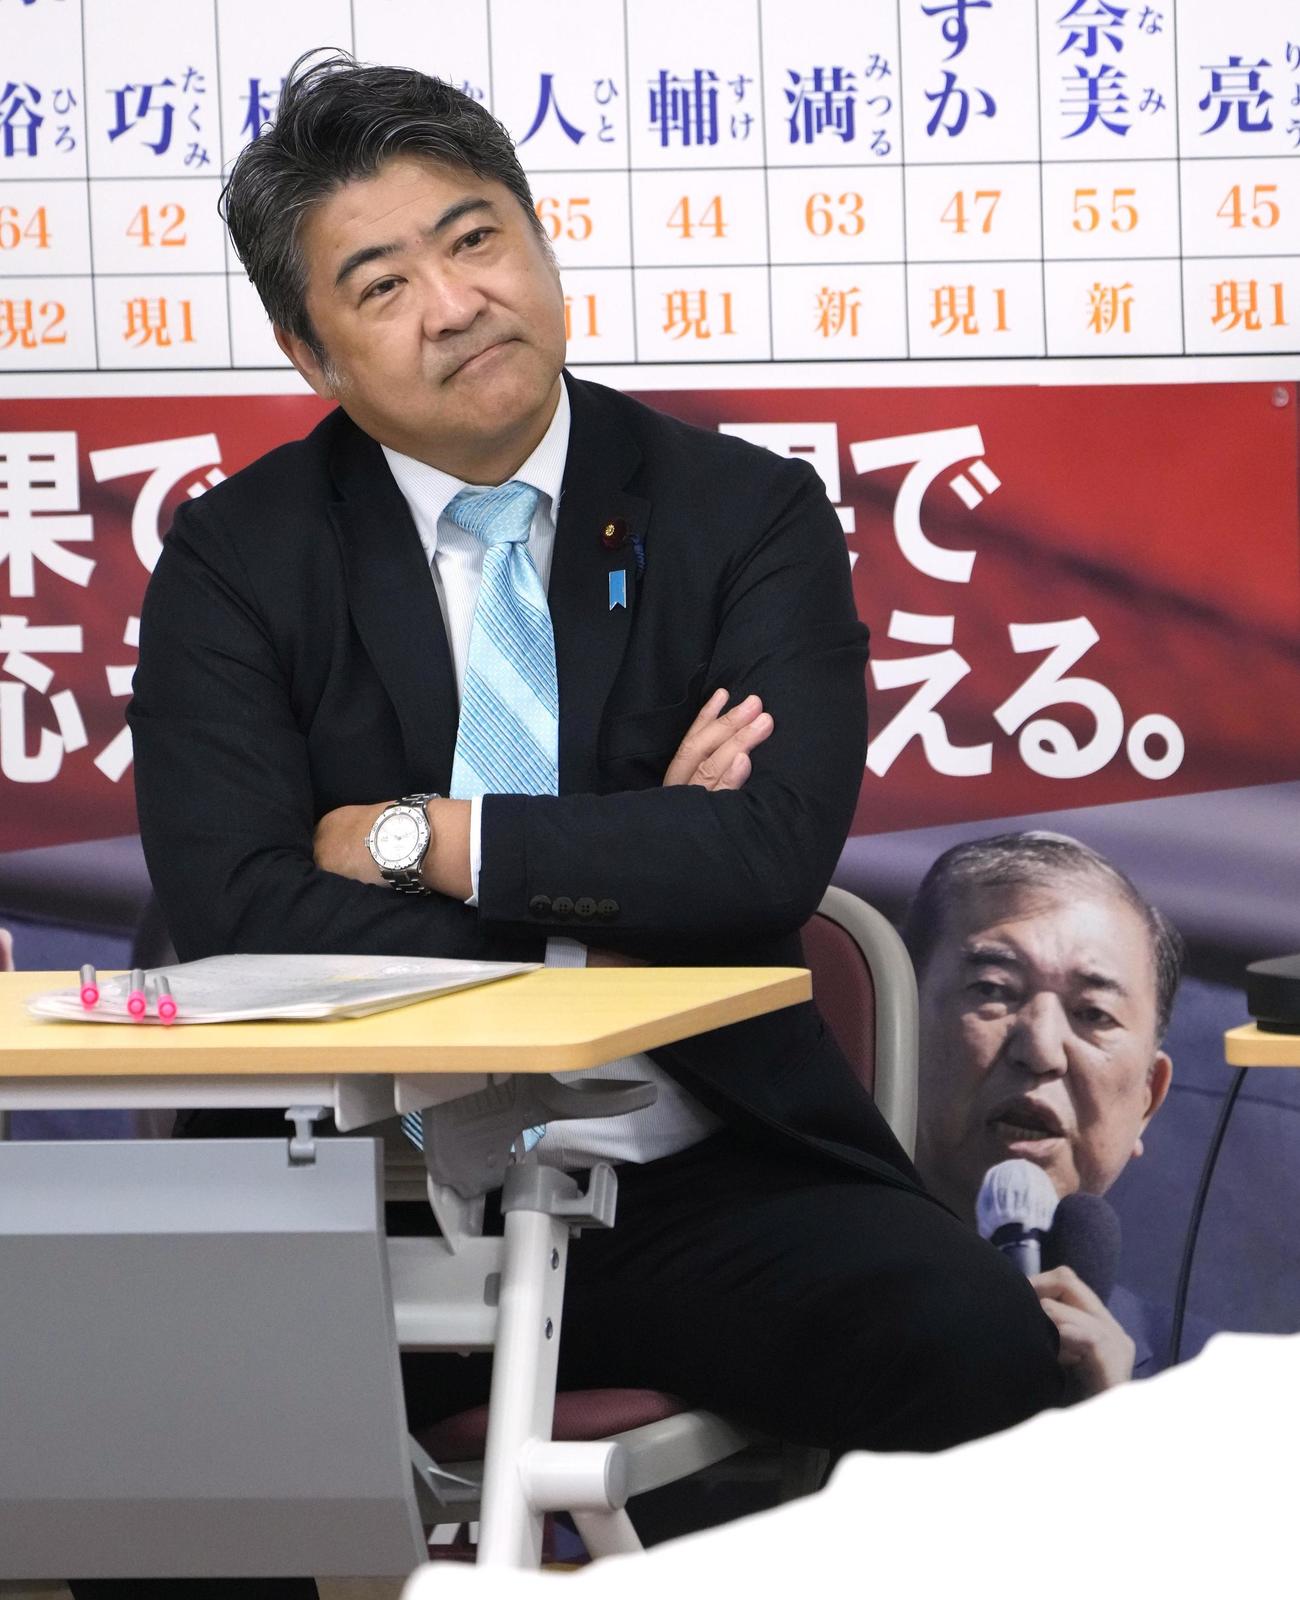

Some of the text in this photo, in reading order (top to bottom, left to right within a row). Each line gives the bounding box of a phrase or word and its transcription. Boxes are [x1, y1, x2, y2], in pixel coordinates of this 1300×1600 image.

[920, 0, 996, 137] すか
[1056, 0, 1132, 139] 奈美
[1138, 6, 1166, 114] なみ
[53, 88, 77, 153] ひろ
[105, 77, 176, 156] 巧
[182, 65, 210, 168] たくみ
[516, 72, 586, 146] 人
[593, 77, 619, 143] ひと
[648, 68, 720, 147] 輔
[727, 74, 754, 140] すけ
[783, 66, 858, 145] 満
[865, 53, 892, 157] みつる
[1198, 55, 1275, 136] 亮
[0, 205, 51, 250] 64
[126, 203, 188, 248] 42
[535, 196, 593, 242] 65
[665, 195, 729, 239] 44
[803, 191, 866, 238] 63
[939, 189, 1002, 236] 47
[1071, 186, 1140, 233] 55
[1215, 183, 1282, 230] 45
[0, 297, 68, 350] 現2
[122, 296, 197, 350] 現1
[661, 288, 738, 341] 現1
[814, 286, 863, 339] 新
[928, 284, 1012, 337] 現1
[1085, 280, 1137, 336] 新
[1209, 278, 1290, 333] 現1
[0, 614, 141, 784] 応
[865, 609, 1186, 781] える。
